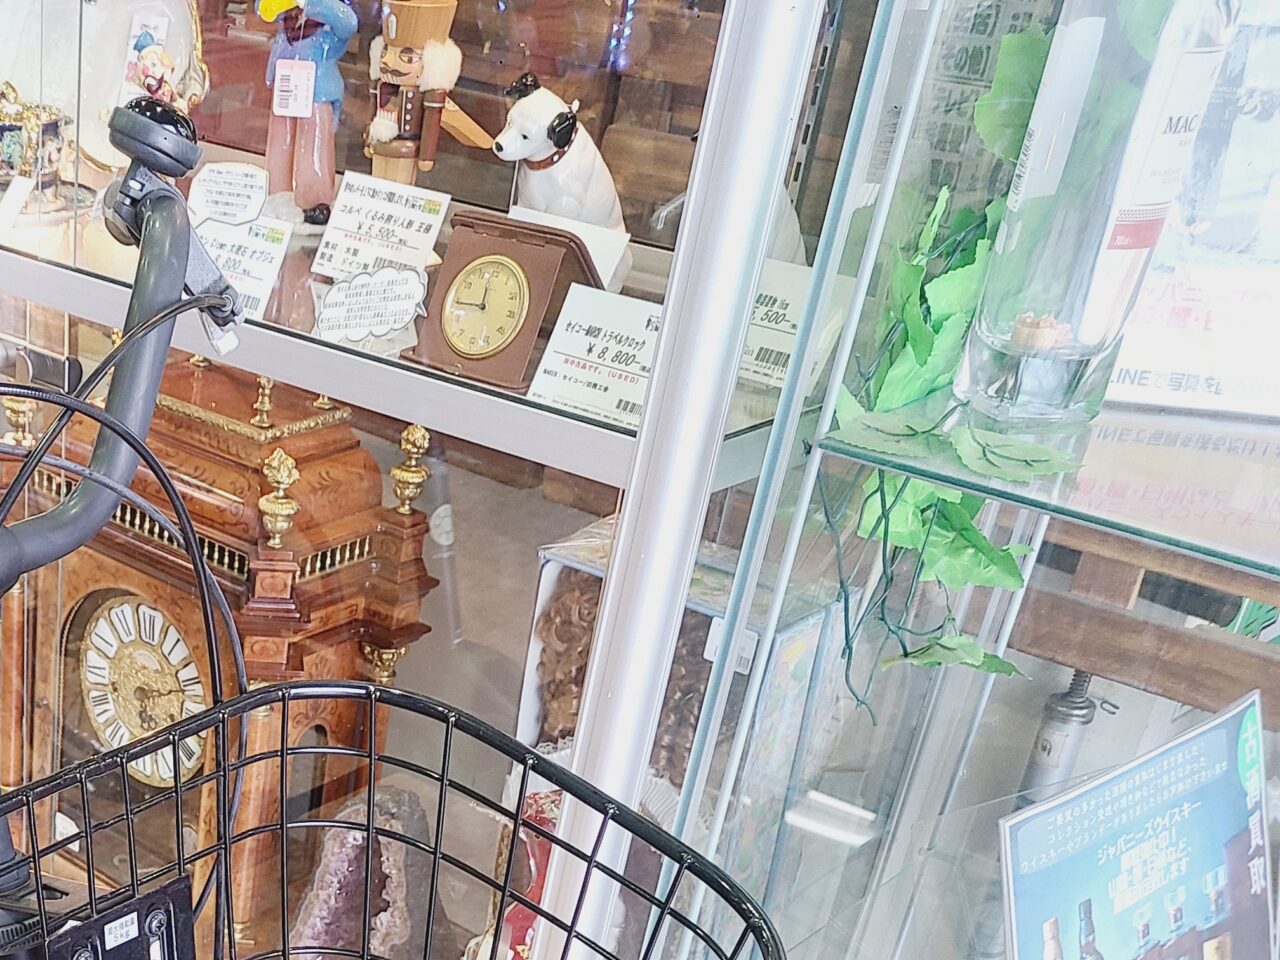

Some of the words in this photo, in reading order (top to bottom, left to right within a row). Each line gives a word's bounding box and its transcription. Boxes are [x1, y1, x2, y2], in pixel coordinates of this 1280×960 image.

[415, 221, 434, 235] 王様
[600, 328, 647, 353] トラベルクロック
[1096, 798, 1202, 866] ジャパニーズウイスキー
